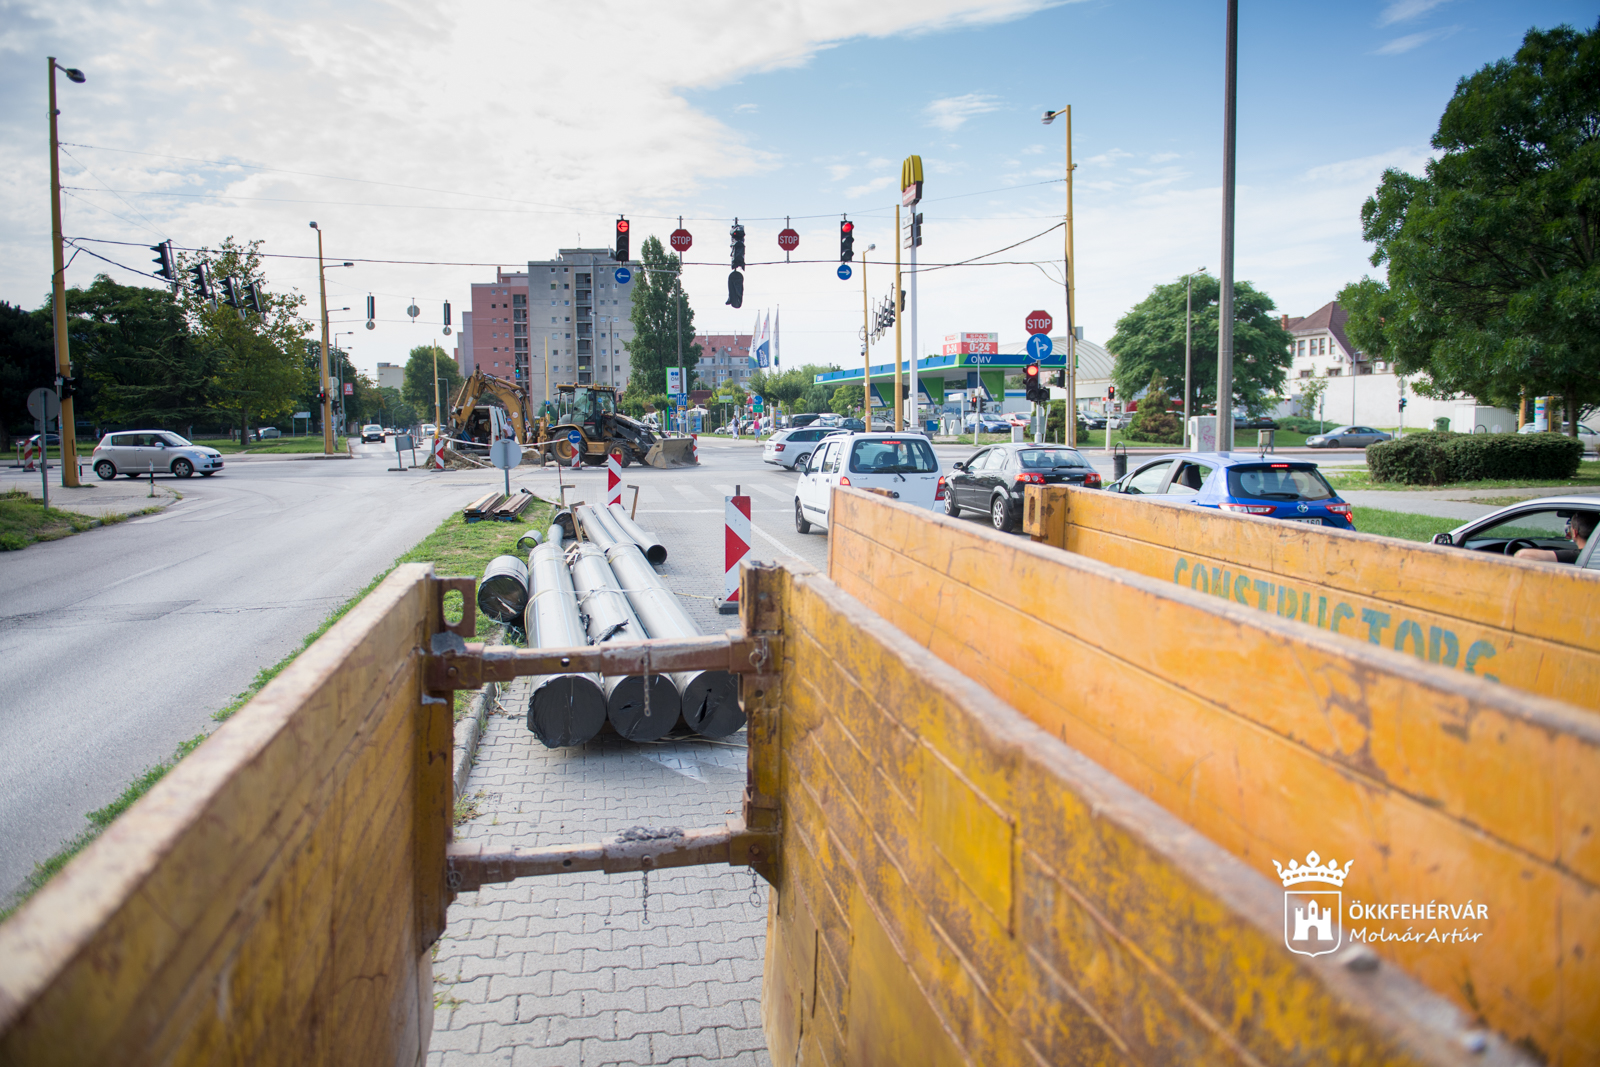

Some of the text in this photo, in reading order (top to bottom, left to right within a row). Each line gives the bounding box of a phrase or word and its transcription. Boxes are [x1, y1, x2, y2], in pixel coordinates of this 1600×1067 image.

[671, 236, 691, 245] STOP
[779, 235, 798, 244] STOP
[1027, 318, 1051, 329] STOP
[970, 342, 990, 352] 0-24
